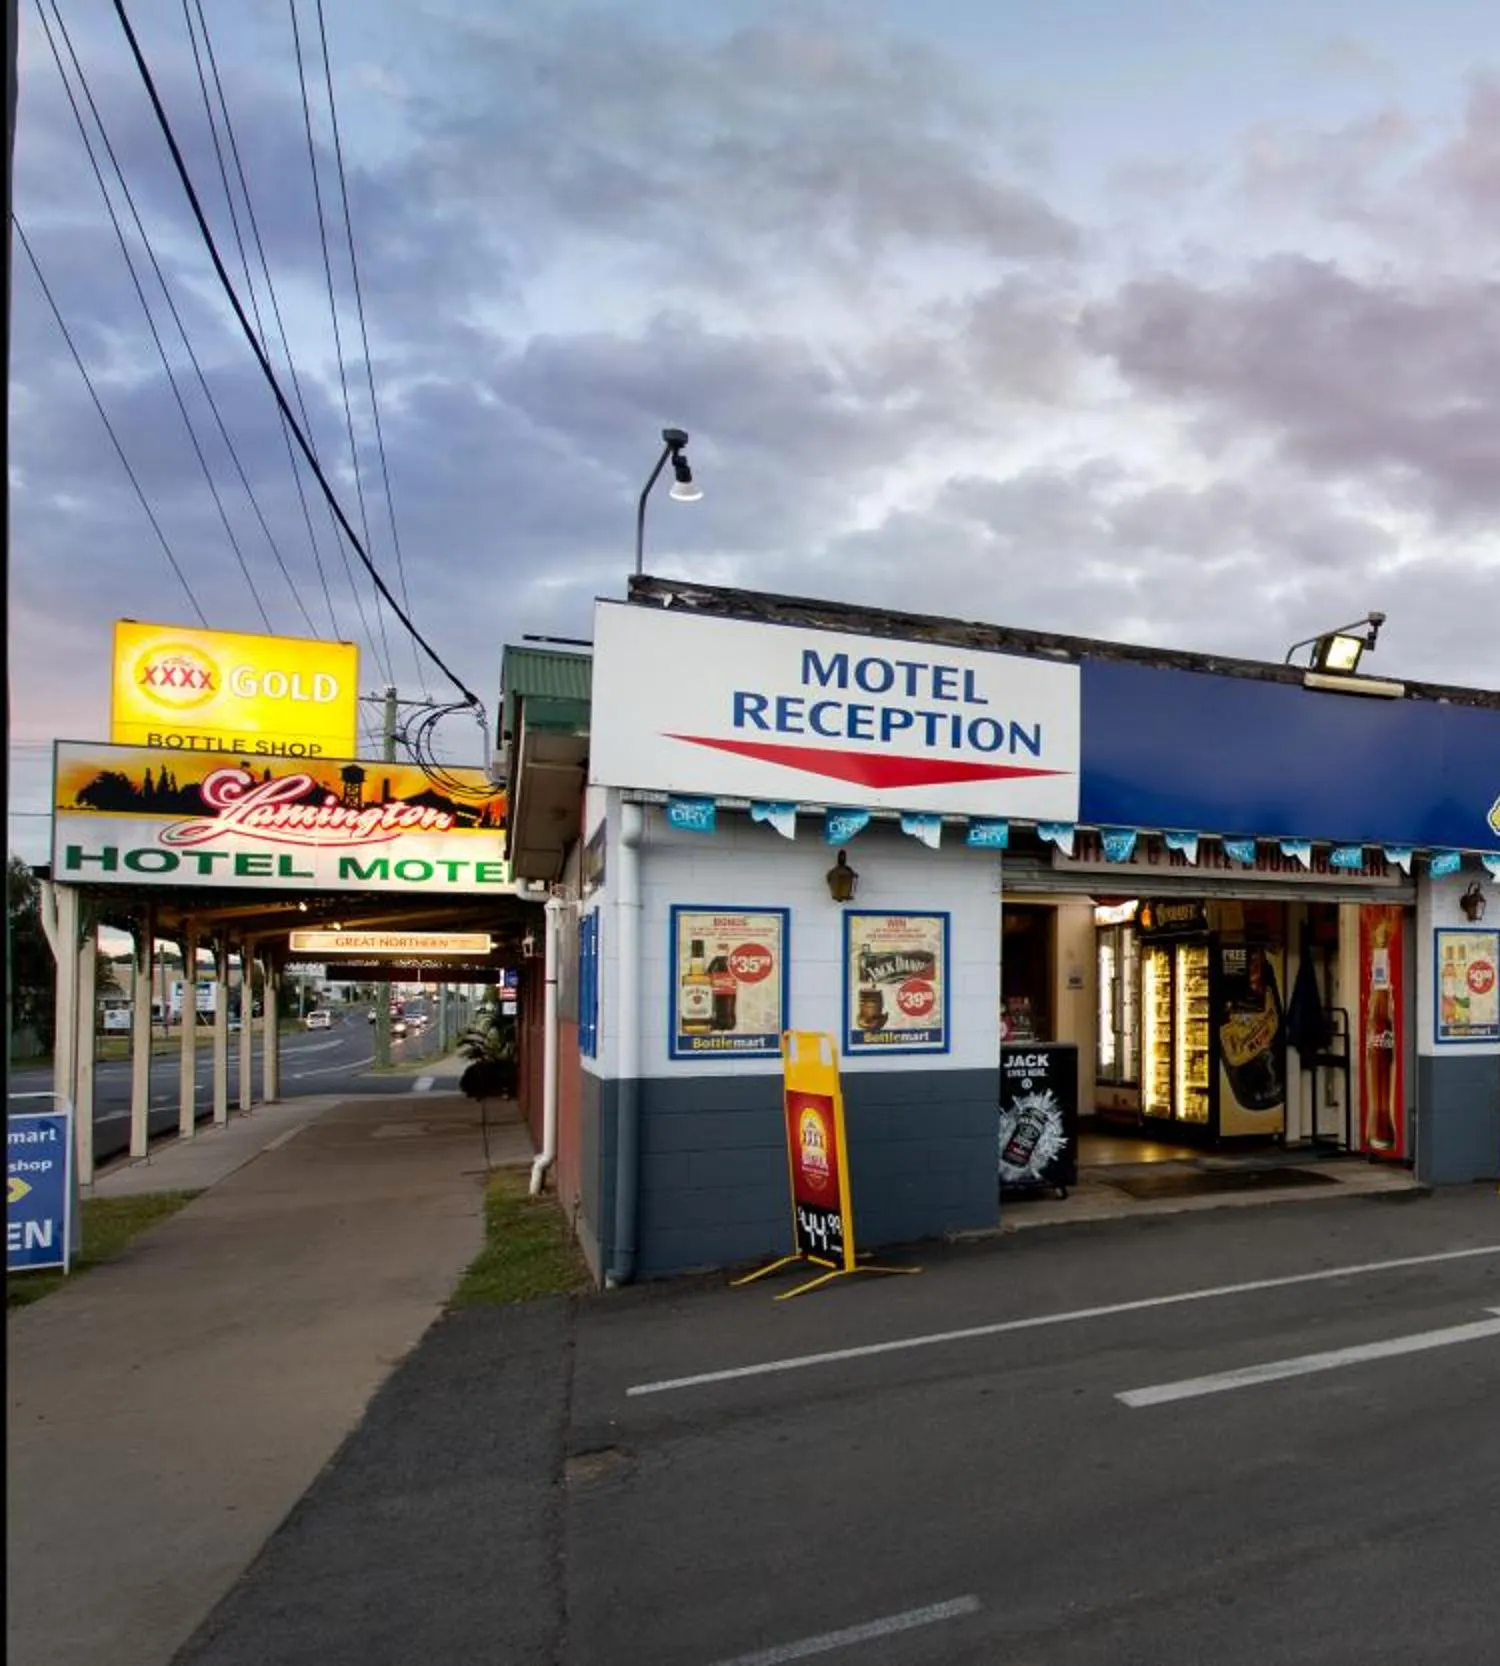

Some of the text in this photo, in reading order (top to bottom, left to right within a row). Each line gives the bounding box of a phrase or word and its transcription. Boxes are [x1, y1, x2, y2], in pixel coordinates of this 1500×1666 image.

[139, 665, 340, 704] XXXX GOLD
[800, 649, 989, 705] MOTEL
[732, 691, 1042, 758] RECEPTION
[147, 732, 323, 758] BOTTLE SHOP
[158, 768, 456, 848] Lamington
[65, 845, 315, 879] HOTEL
[335, 936, 375, 948] GREAT
[379, 936, 449, 949] NORTHERN
[1003, 1053, 1049, 1068] JACK
[7, 1128, 57, 1145] mart
[8, 1159, 54, 1174] shop
